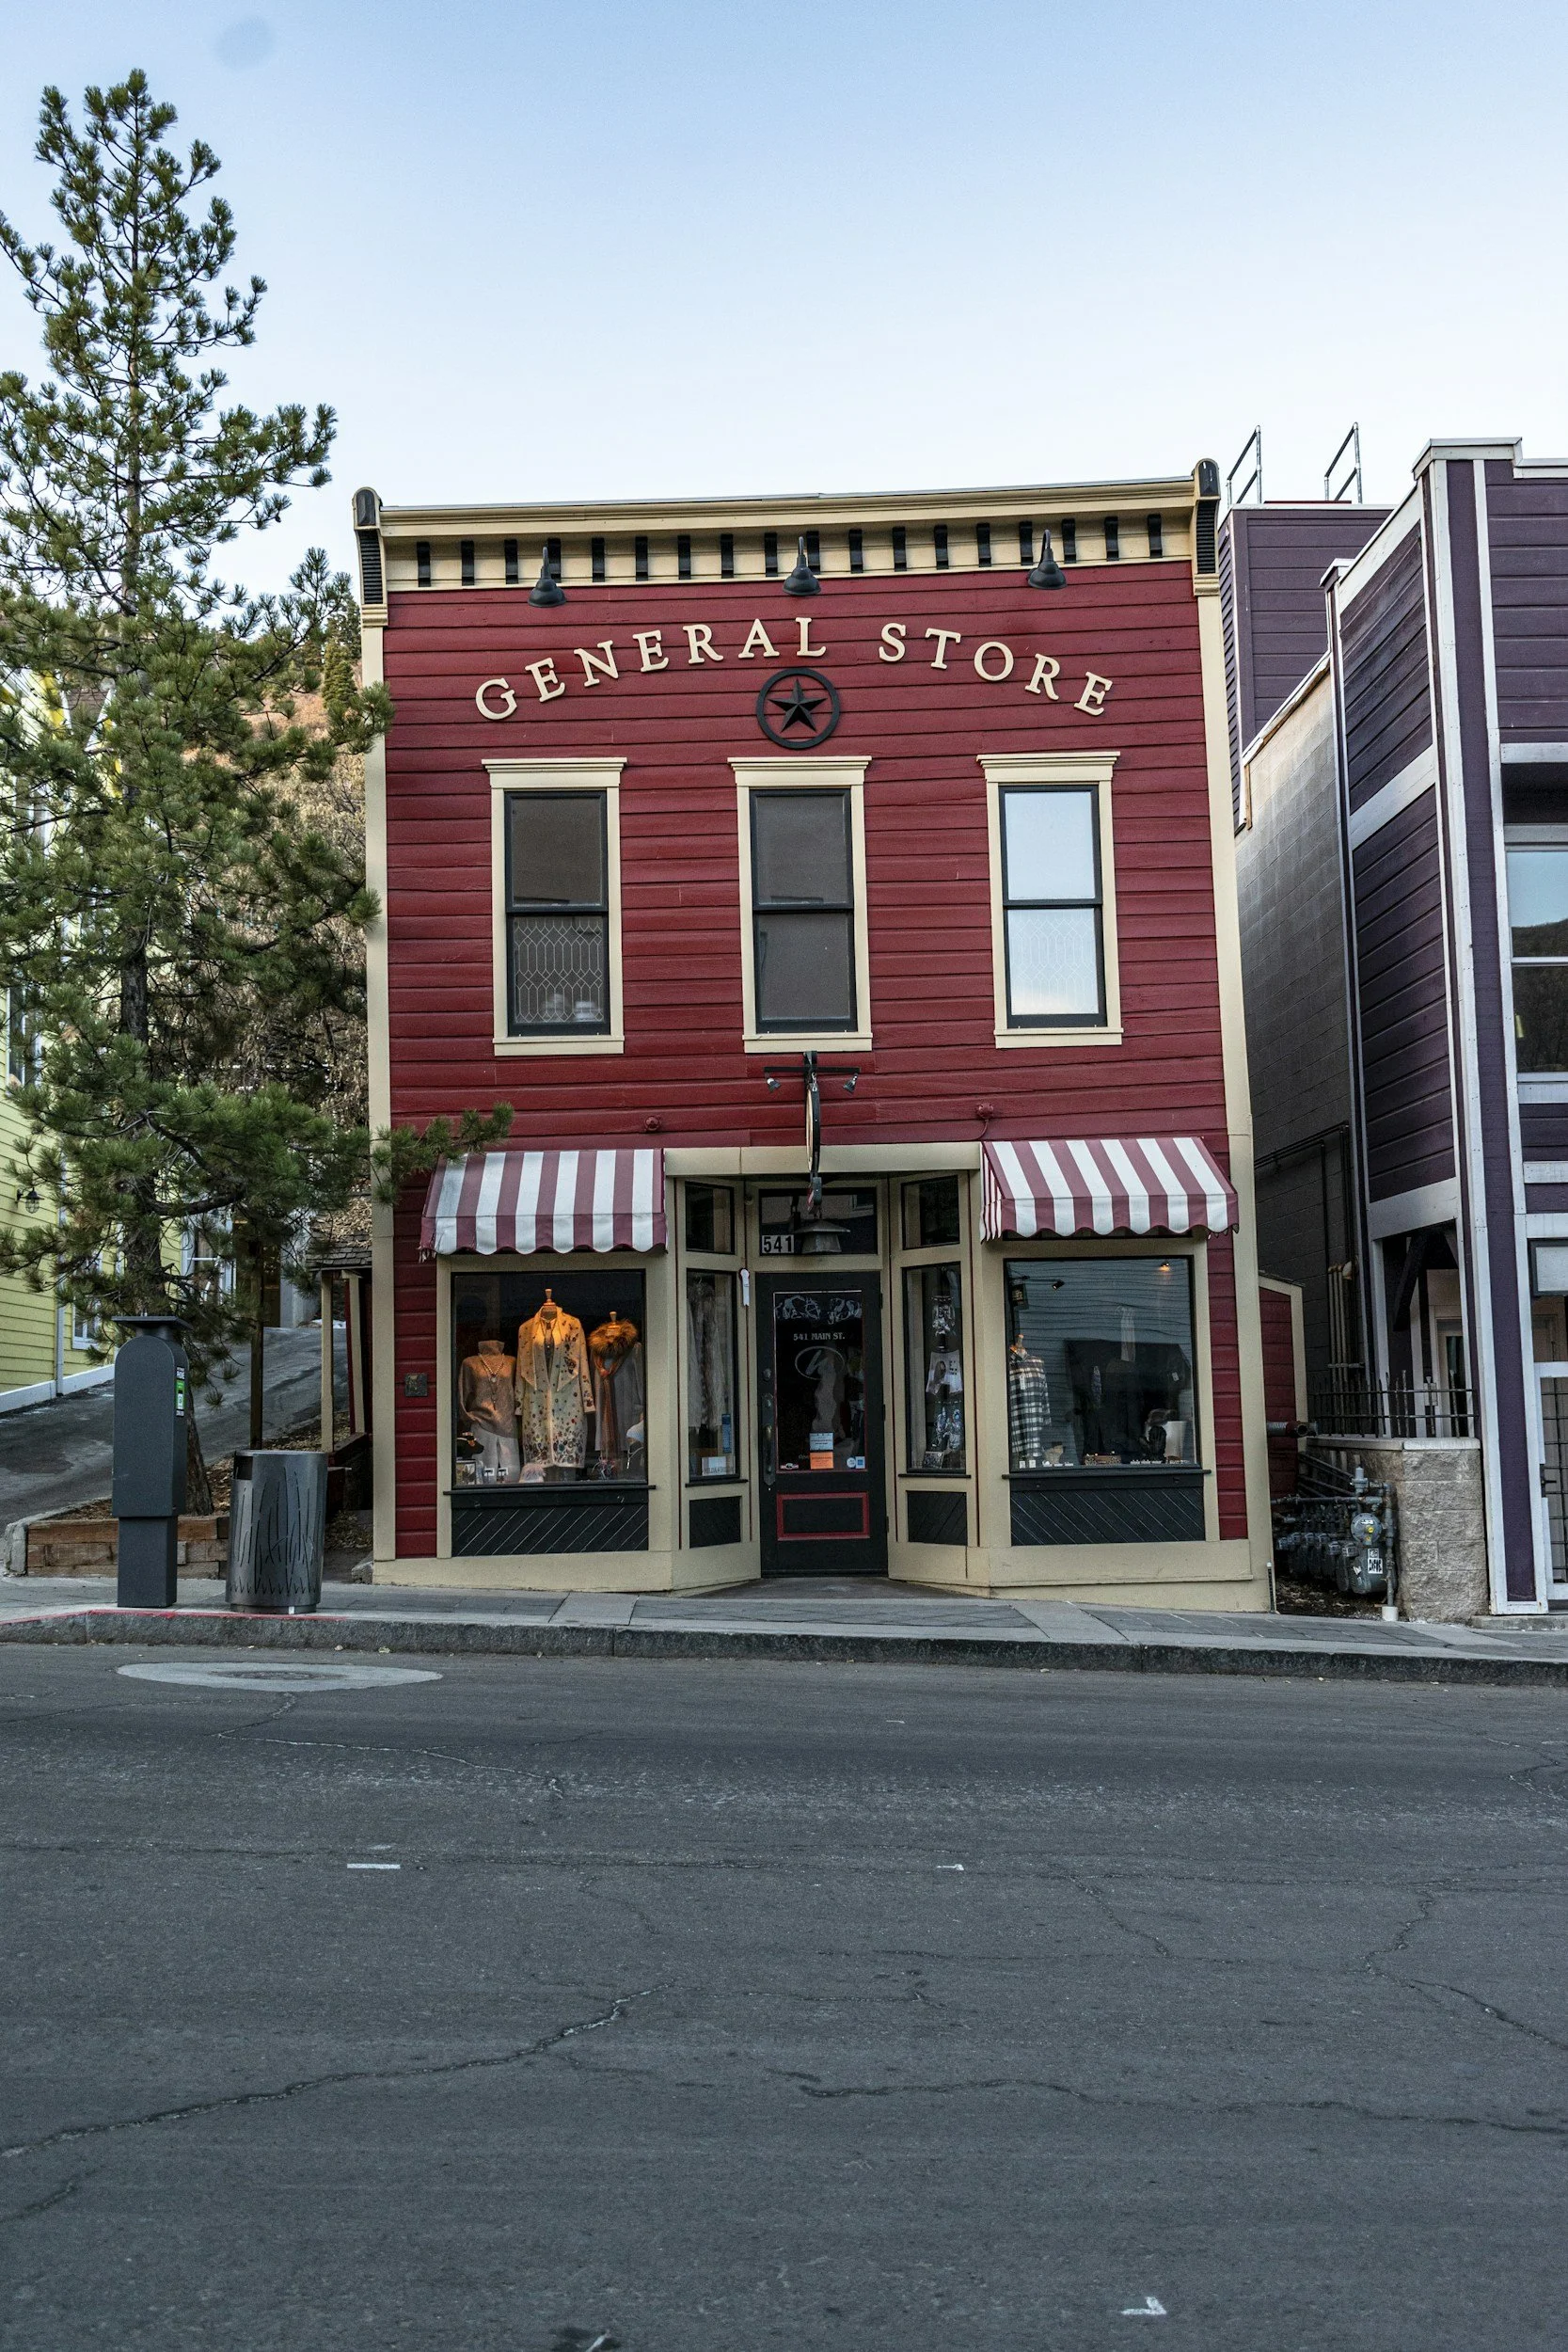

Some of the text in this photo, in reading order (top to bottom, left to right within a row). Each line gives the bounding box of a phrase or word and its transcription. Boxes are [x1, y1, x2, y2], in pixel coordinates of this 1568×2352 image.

[475, 616, 1114, 720] GENERAL STORE
[763, 1235, 792, 1253] 541
[793, 1331, 846, 1342] 541 MAIN ST.
